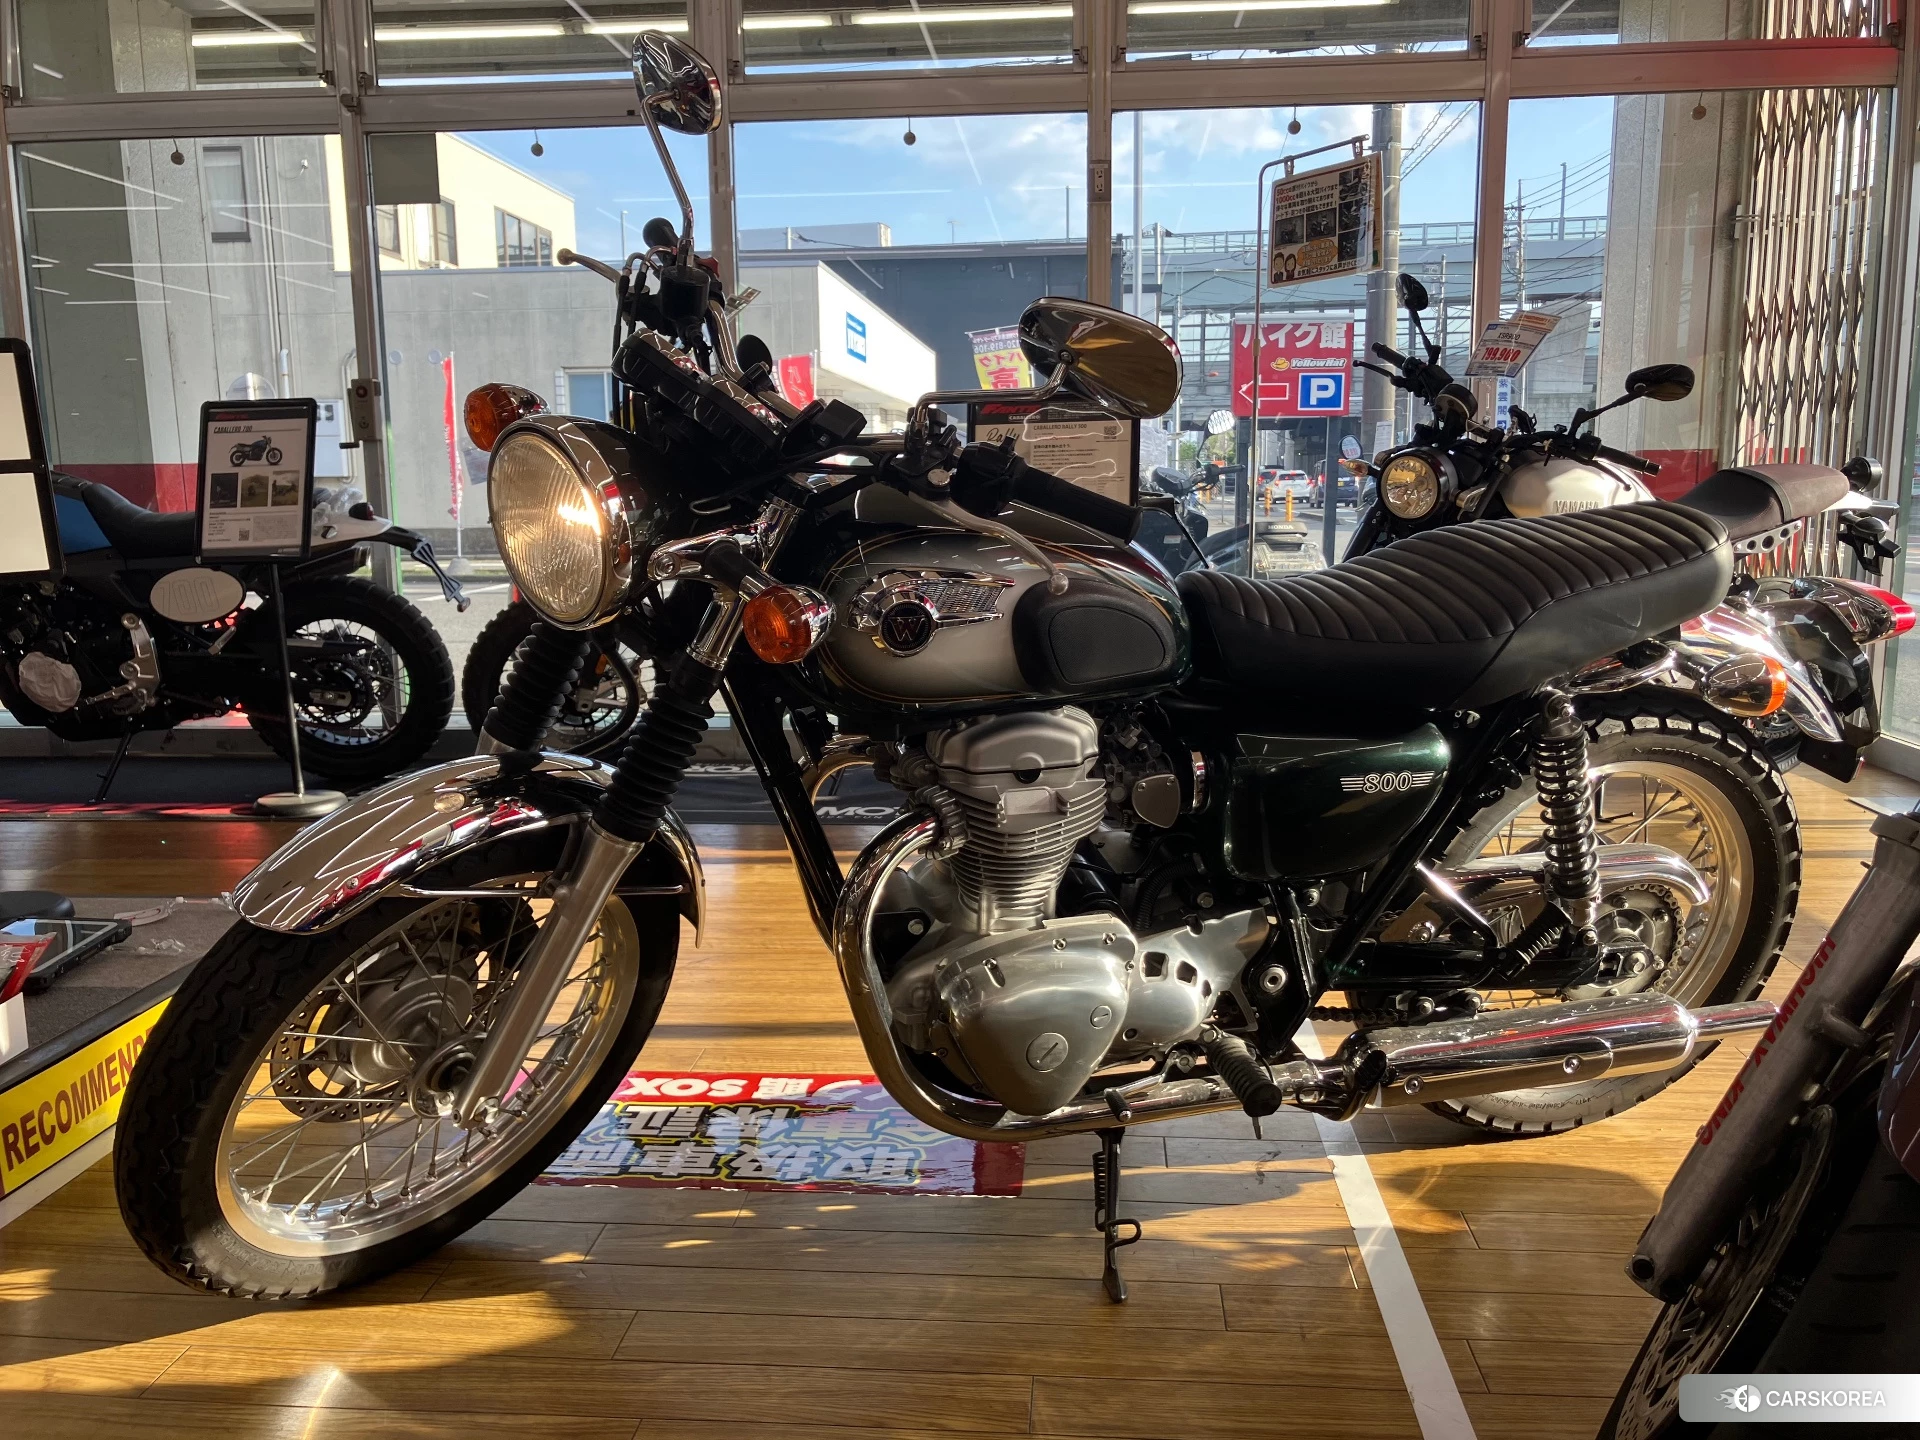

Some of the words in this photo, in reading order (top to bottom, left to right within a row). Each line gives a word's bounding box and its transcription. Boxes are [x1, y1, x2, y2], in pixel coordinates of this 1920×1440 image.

[1241, 322, 1347, 348] バイク館
[1309, 377, 1336, 405] P
[213, 426, 242, 434] CABALLERO
[1553, 500, 1600, 514] YAMAHA
[1362, 771, 1413, 793] 800
[816, 806, 901, 816] MO
[618, 1077, 748, 1098] SOX
[752, 1077, 889, 1101] イク館
[1, 1027, 154, 1172] RECOMMEND
[580, 1104, 941, 1142] 全車保証
